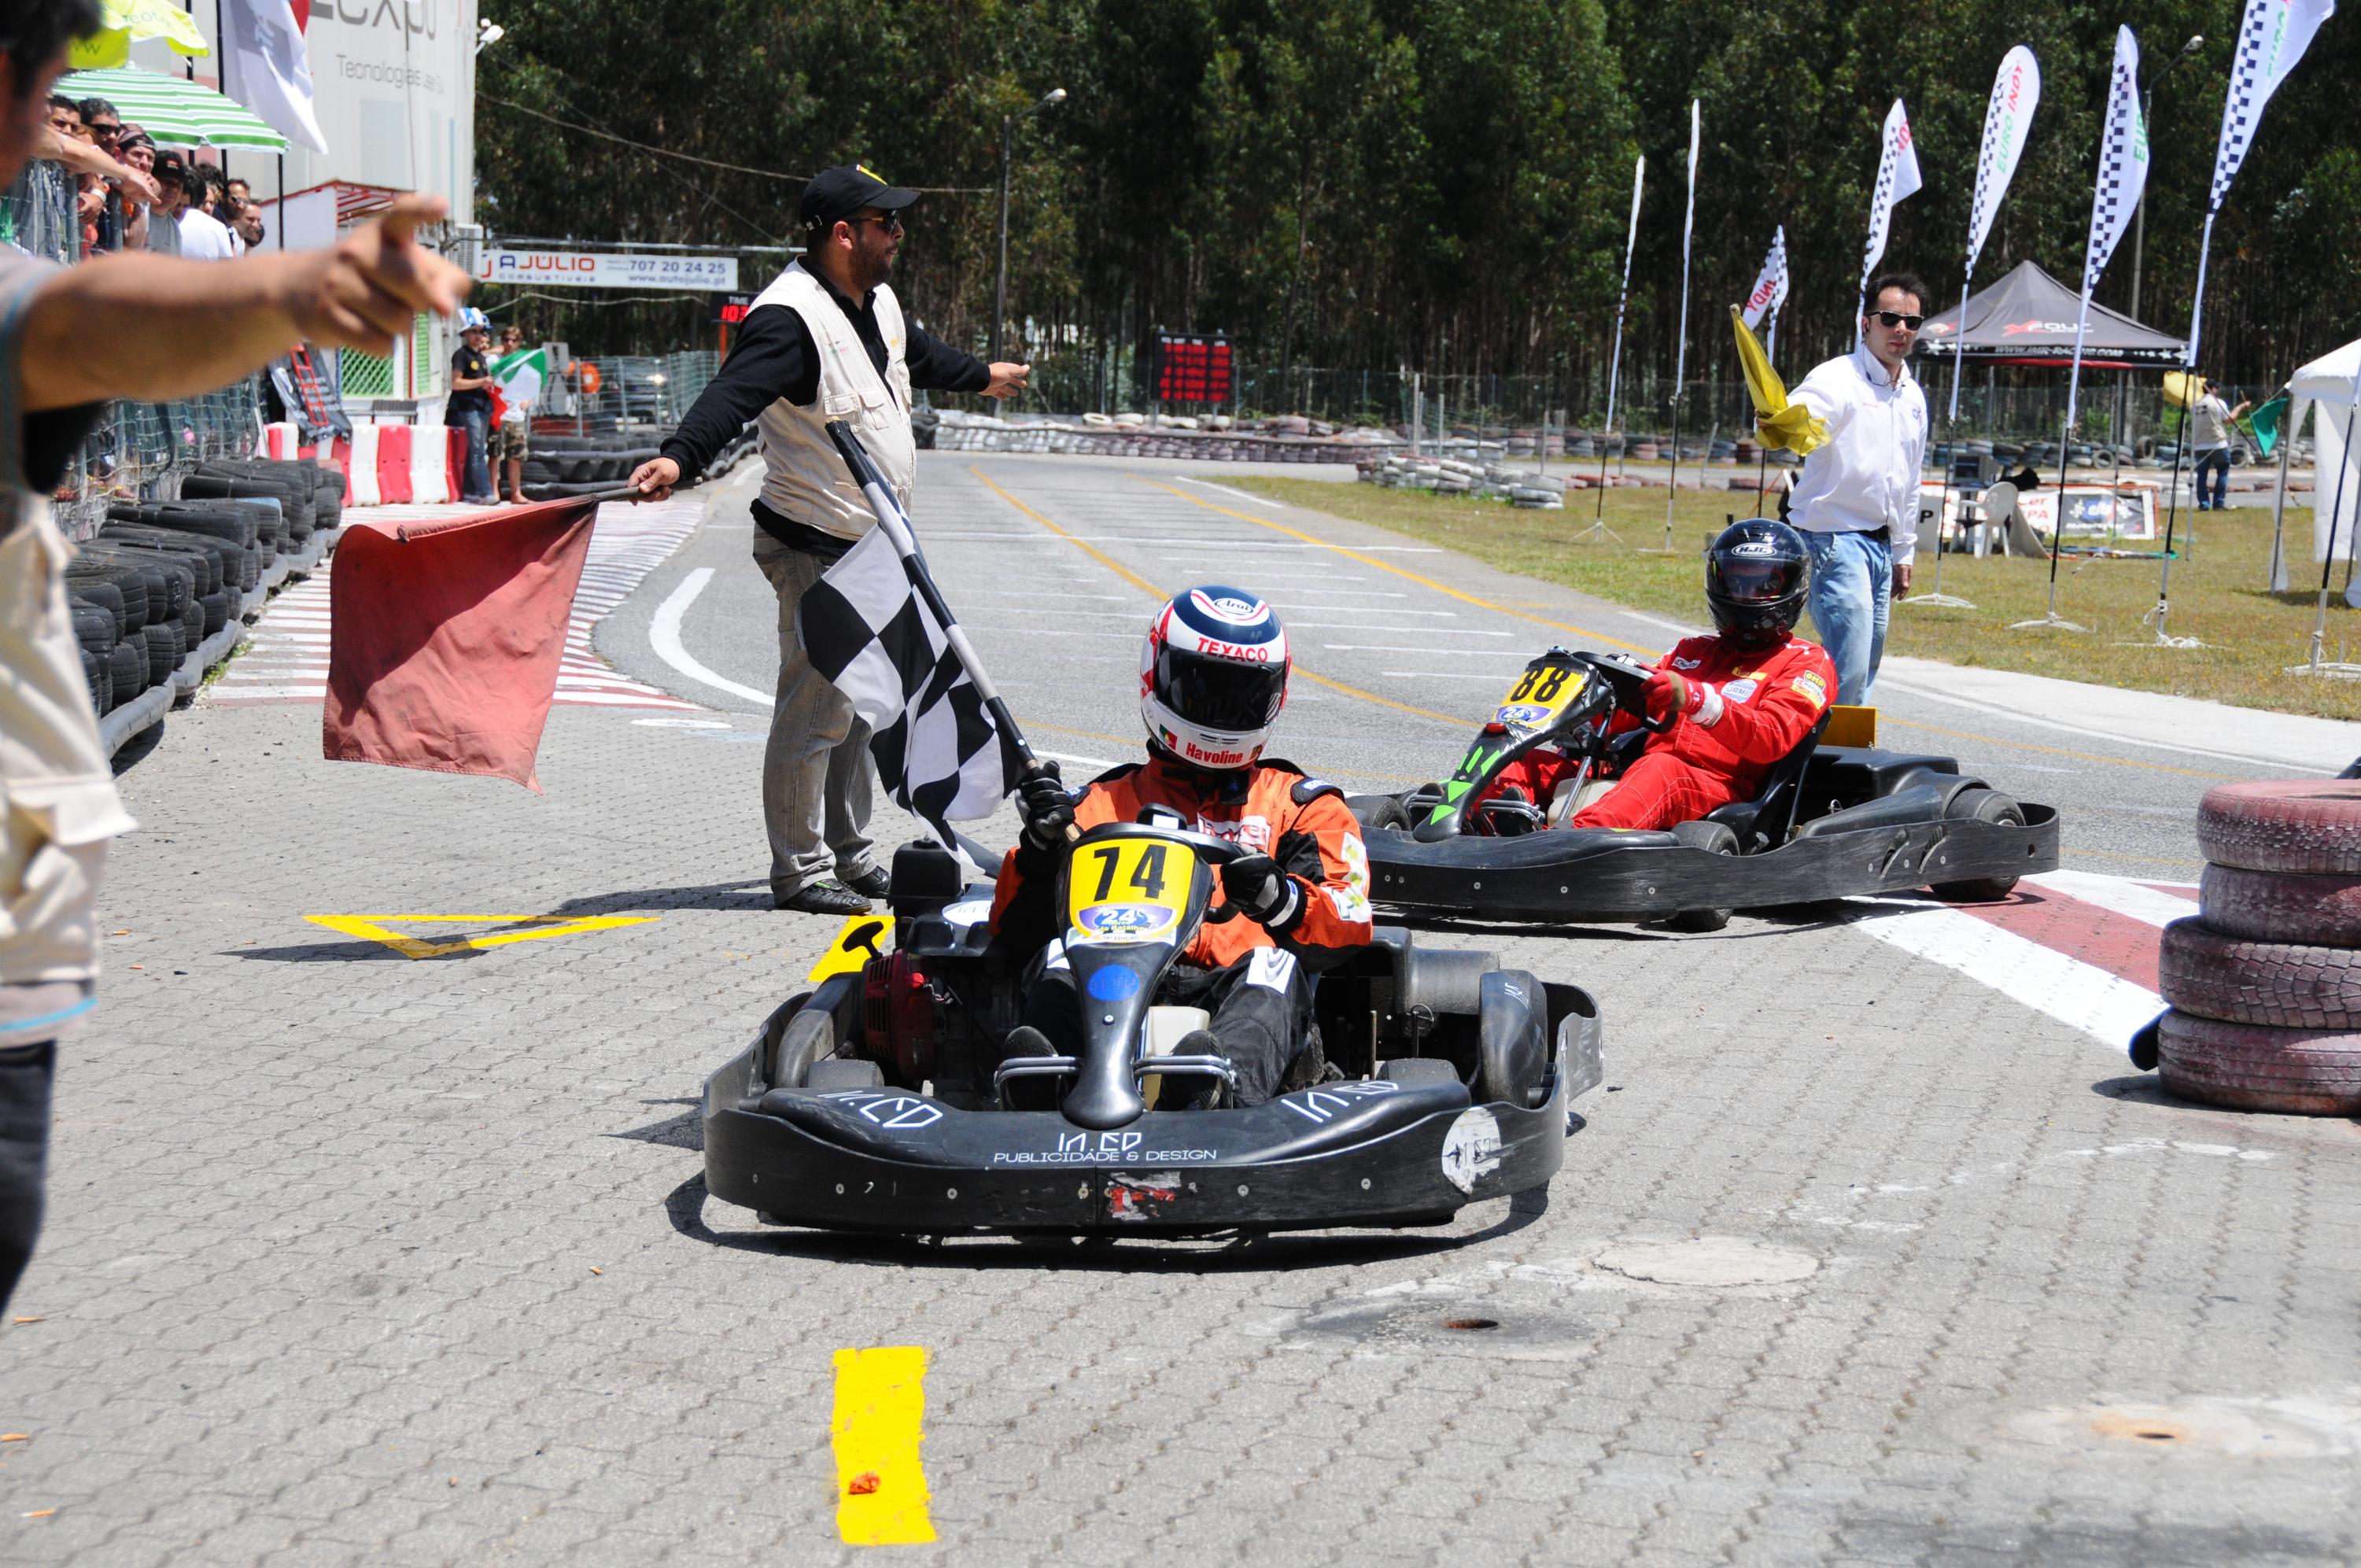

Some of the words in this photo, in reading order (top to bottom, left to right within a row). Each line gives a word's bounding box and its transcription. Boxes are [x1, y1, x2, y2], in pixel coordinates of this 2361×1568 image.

[1997, 114, 2014, 174] EURO
[2007, 62, 2024, 113] INDY
[630, 260, 655, 271] 707
[662, 261, 680, 272] 20
[685, 262, 703, 272] 24
[709, 263, 726, 274] 25
[1224, 600, 1250, 611] Arai
[1196, 636, 1268, 663] TEXACO
[1511, 666, 1571, 703] 88
[1806, 672, 1825, 688] OMP
[1186, 742, 1244, 765] Havoline
[1094, 844, 1167, 902] 74
[1101, 909, 1137, 925] 24
[994, 1151, 1120, 1163] PUBLICIDADE
[1126, 1151, 1139, 1160] &
[1145, 1149, 1218, 1161] DESIGN
